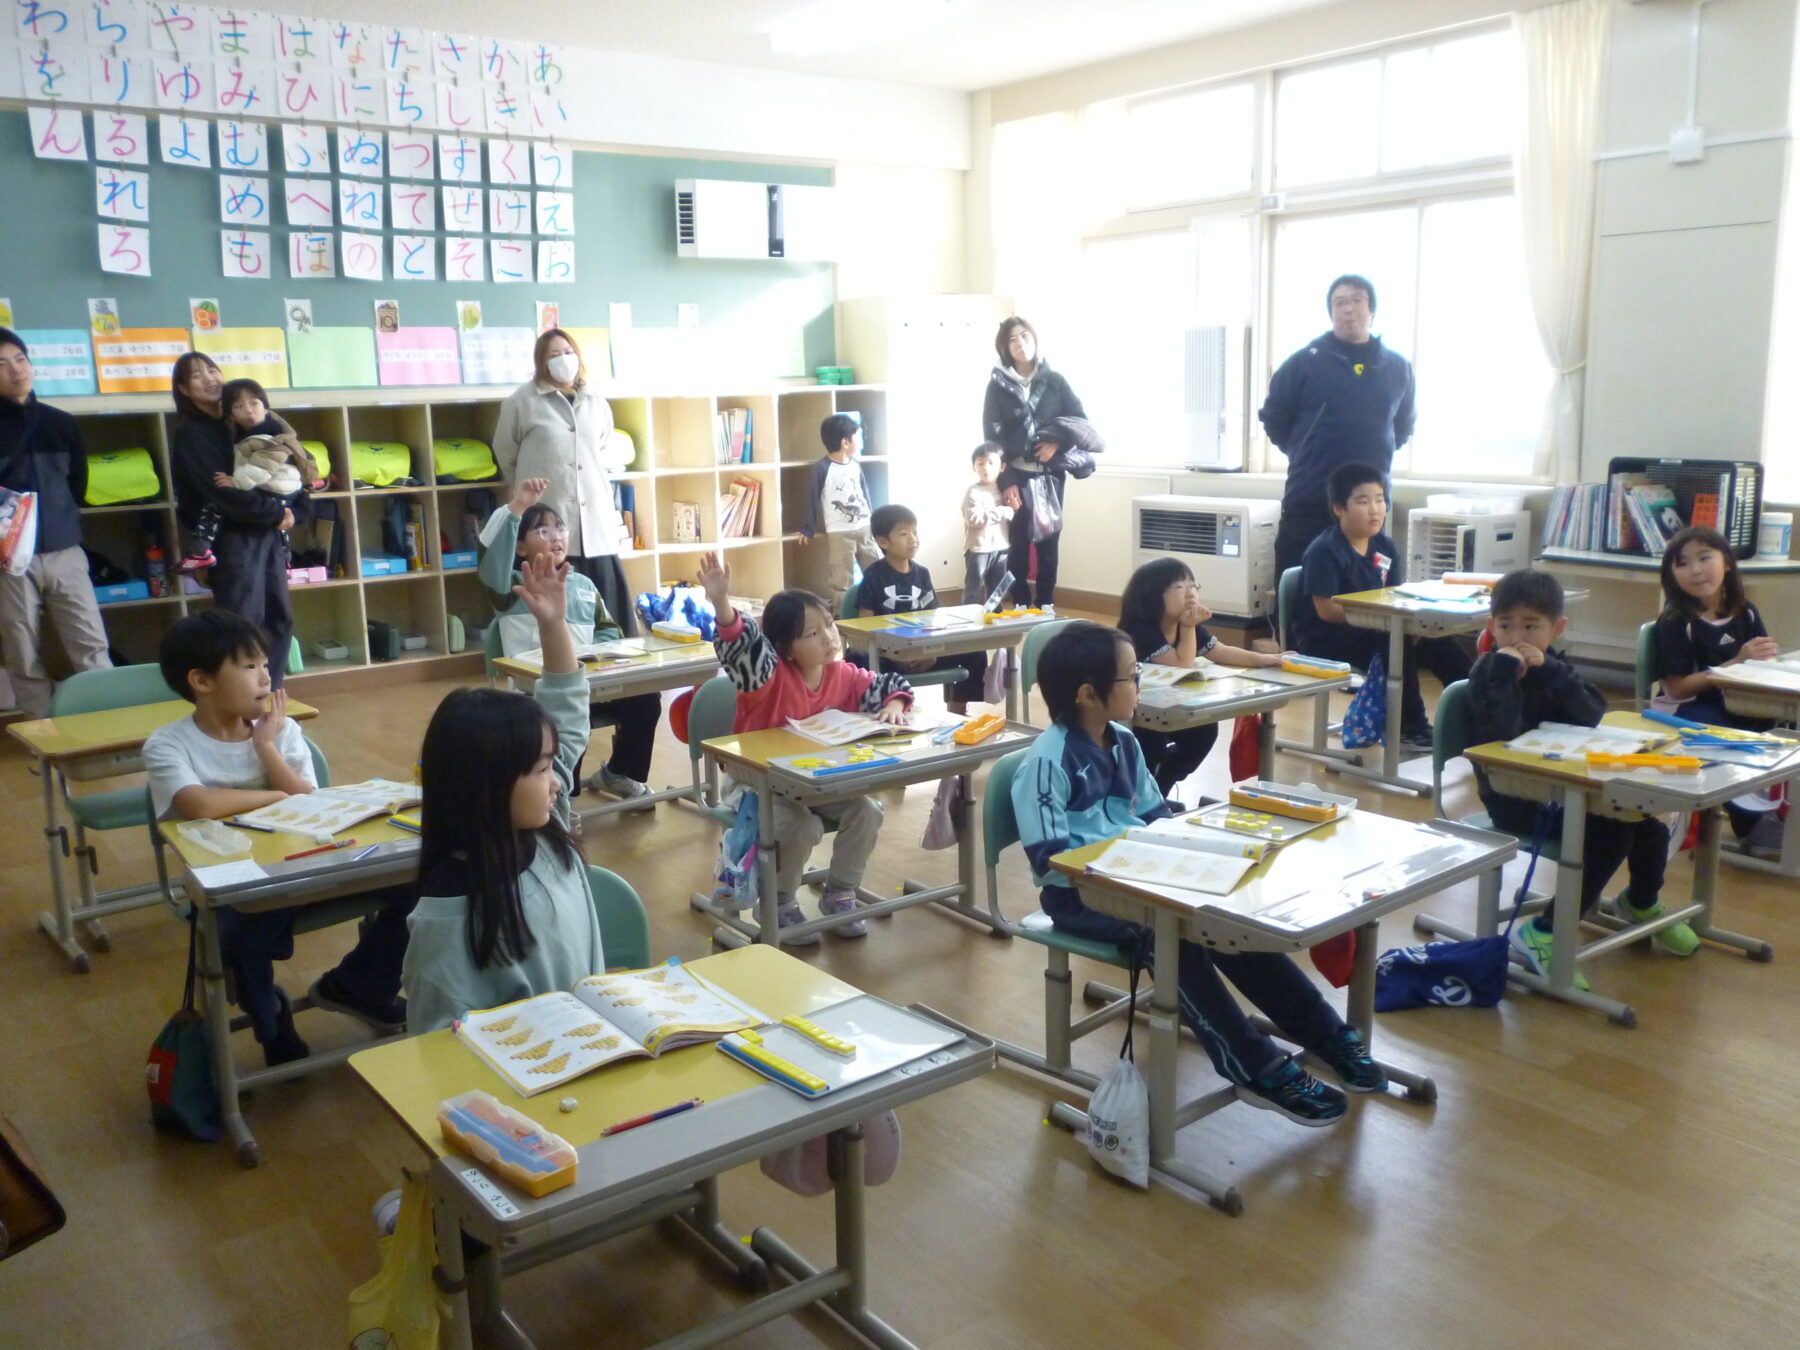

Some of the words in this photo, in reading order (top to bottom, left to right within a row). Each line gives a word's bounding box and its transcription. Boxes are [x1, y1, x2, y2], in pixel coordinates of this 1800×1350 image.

[23, 0, 67, 35] わ
[97, 0, 127, 43] ら
[154, 5, 194, 48] や
[220, 13, 250, 54] ま
[280, 22, 317, 57] は
[334, 25, 368, 64] な
[388, 32, 420, 70] た
[440, 38, 468, 74] さ
[34, 53, 65, 96] を
[486, 44, 519, 79] か
[534, 47, 562, 84] あ
[104, 59, 128, 101] り
[160, 66, 201, 103] ゆ
[221, 72, 260, 109] み
[285, 78, 318, 112] ひ
[341, 80, 374, 115] に
[395, 83, 423, 122] ち
[448, 90, 471, 125] し
[495, 92, 517, 129] き
[534, 104, 566, 127] い
[39, 112, 82, 154] ん
[107, 120, 136, 156] る
[169, 122, 202, 160] よ
[224, 125, 262, 166] む
[287, 130, 326, 167] ふ
[343, 135, 380, 166] ぬ
[394, 144, 430, 168] つ
[442, 139, 476, 178] す
[502, 143, 517, 181] く
[543, 145, 562, 184] う
[103, 173, 145, 214] れ
[226, 184, 264, 218] め
[289, 192, 331, 213] へ
[344, 184, 378, 220] ね
[398, 192, 427, 224] て
[447, 192, 479, 224] せ
[497, 194, 527, 230] け
[543, 195, 569, 231] え
[110, 232, 142, 271] ろ
[231, 232, 261, 274] も
[297, 237, 330, 273] ほ
[347, 242, 377, 272] の
[402, 241, 425, 274] と
[452, 241, 477, 278] そ
[500, 245, 523, 277] こ
[545, 243, 571, 278] お
